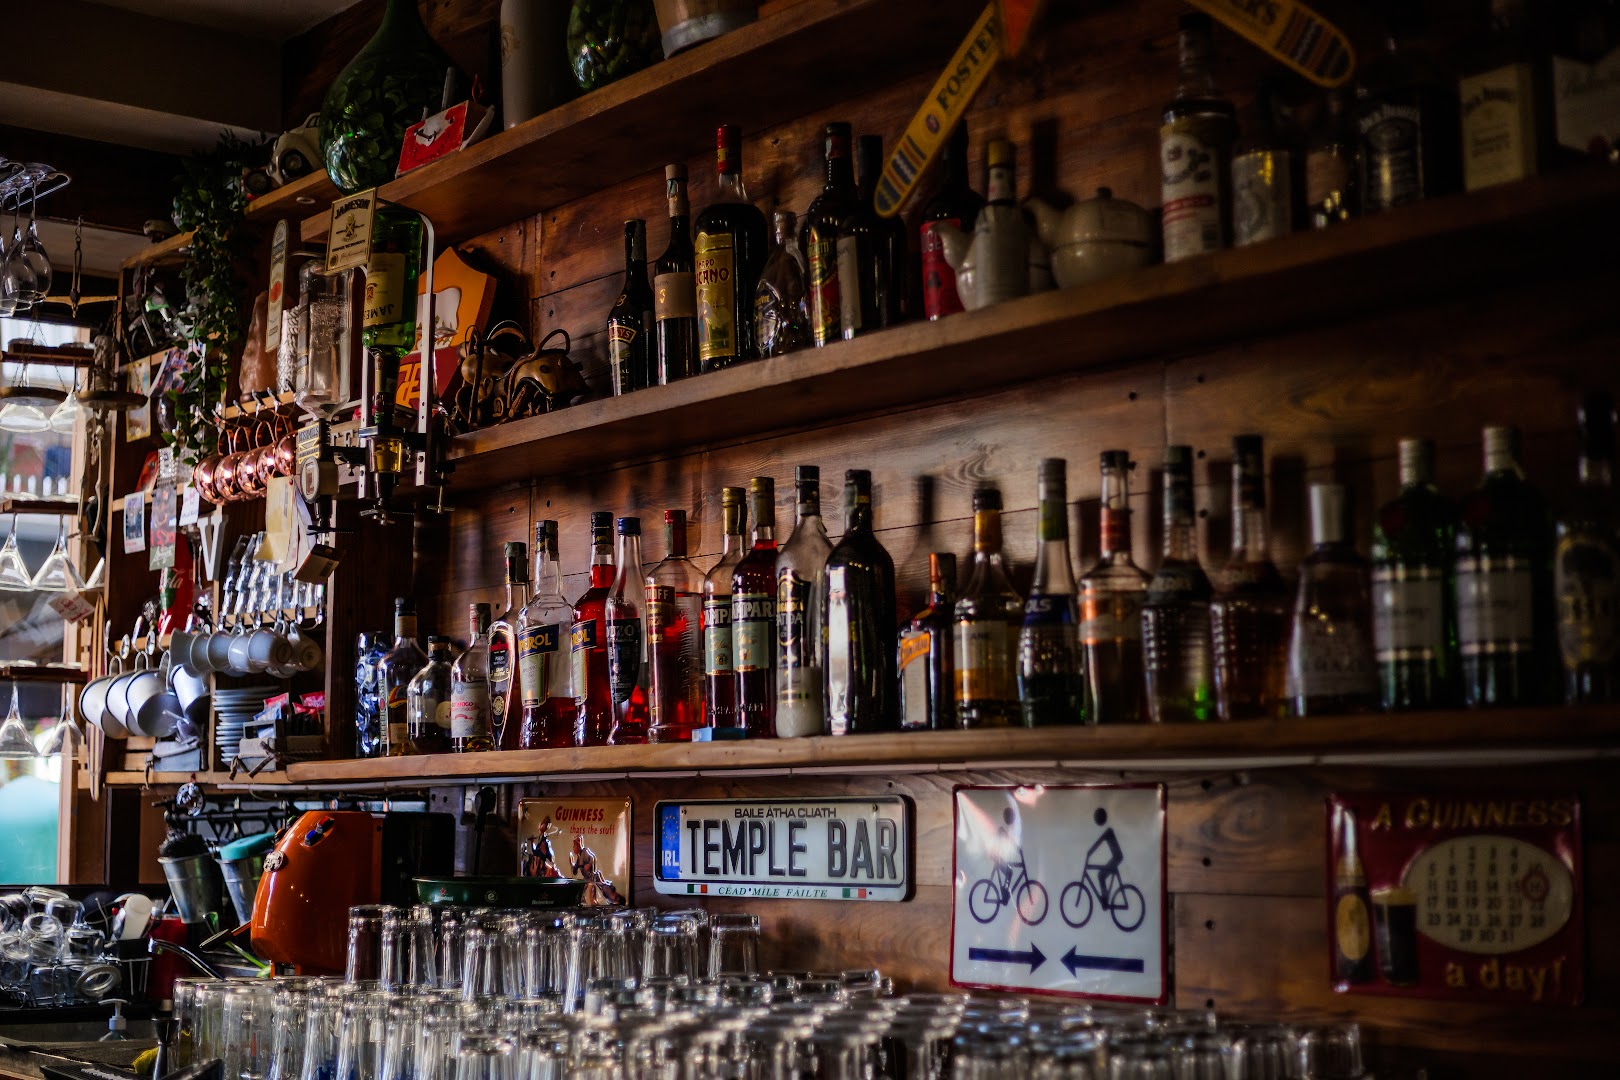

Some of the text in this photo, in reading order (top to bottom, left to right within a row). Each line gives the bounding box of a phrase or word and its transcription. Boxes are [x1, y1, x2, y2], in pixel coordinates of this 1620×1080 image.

[696, 267, 729, 286] CANO
[555, 805, 604, 822] GUINNESS
[734, 807, 764, 818] BAILE
[766, 805, 795, 818] ÁTHA
[1370, 798, 1572, 831] A GUINNESS
[686, 818, 897, 879] TEMPLE BAR
[662, 850, 680, 867] IRL
[718, 885, 828, 898] CÉAD MÍLE FÁILTE
[1446, 961, 1466, 988] a
